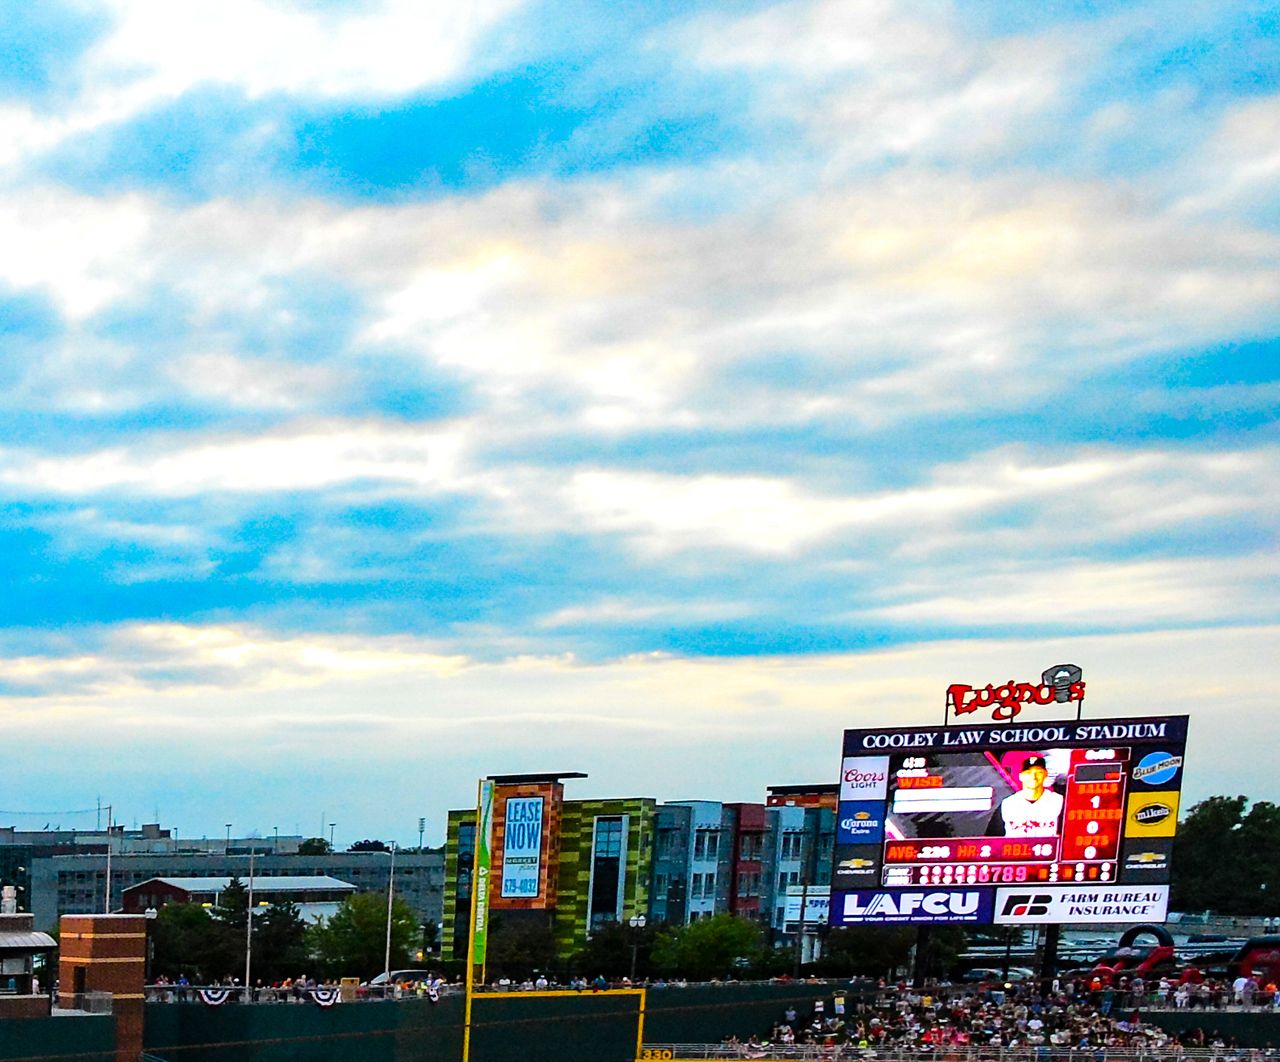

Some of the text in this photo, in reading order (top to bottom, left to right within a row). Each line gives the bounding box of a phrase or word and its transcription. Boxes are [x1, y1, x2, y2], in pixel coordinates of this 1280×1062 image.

[862, 723, 1167, 749] COOLEY LAW SCHOOL STADIUM
[1158, 757, 1182, 771] MOON
[844, 768, 885, 783] Coors
[851, 781, 877, 789] LIGHT
[1090, 795, 1101, 809] 1
[507, 802, 541, 822] LEASE
[841, 818, 879, 830] Corona
[1086, 820, 1099, 834] 0
[506, 823, 540, 850] NOW
[1084, 846, 1097, 859] 0
[844, 892, 980, 915] LAFCU
[1060, 892, 1162, 903] FARM BUREAU
[1068, 905, 1150, 916] INSURANCE
[643, 1049, 672, 1060] 330
